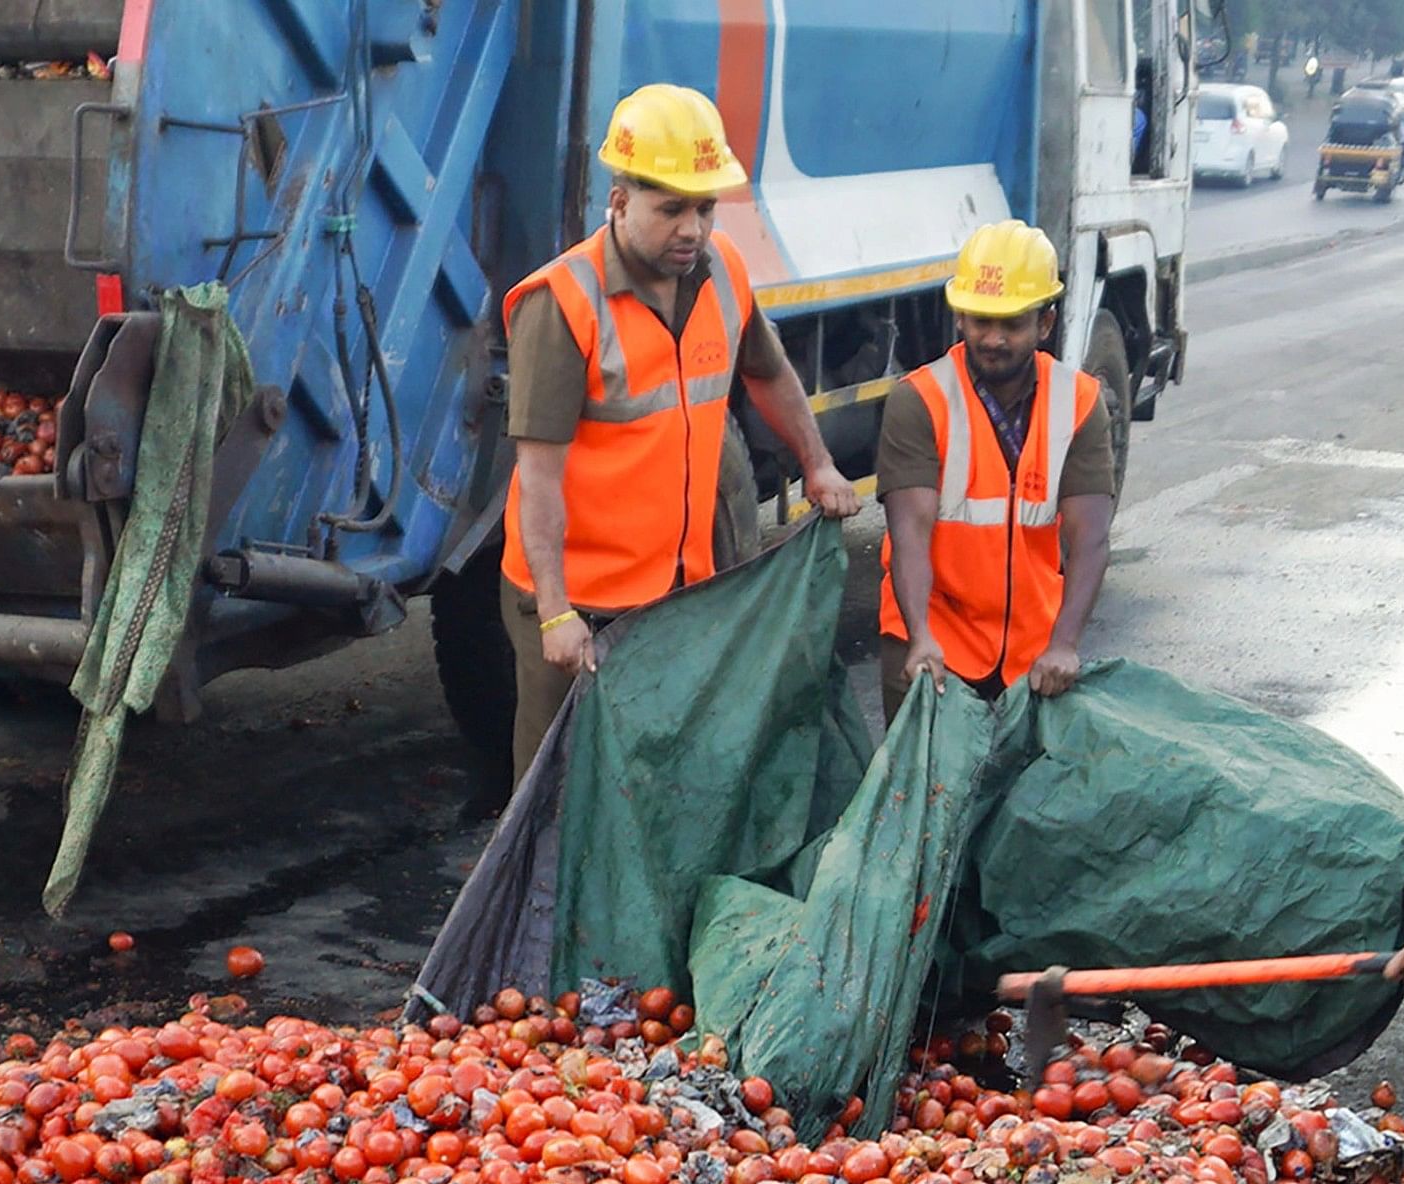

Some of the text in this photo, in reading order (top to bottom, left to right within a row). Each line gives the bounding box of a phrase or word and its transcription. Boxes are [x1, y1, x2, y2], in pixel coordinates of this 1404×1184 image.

[694, 138, 715, 155] TMC
[980, 264, 1003, 280] TMC
[973, 279, 1004, 297] RDMC
